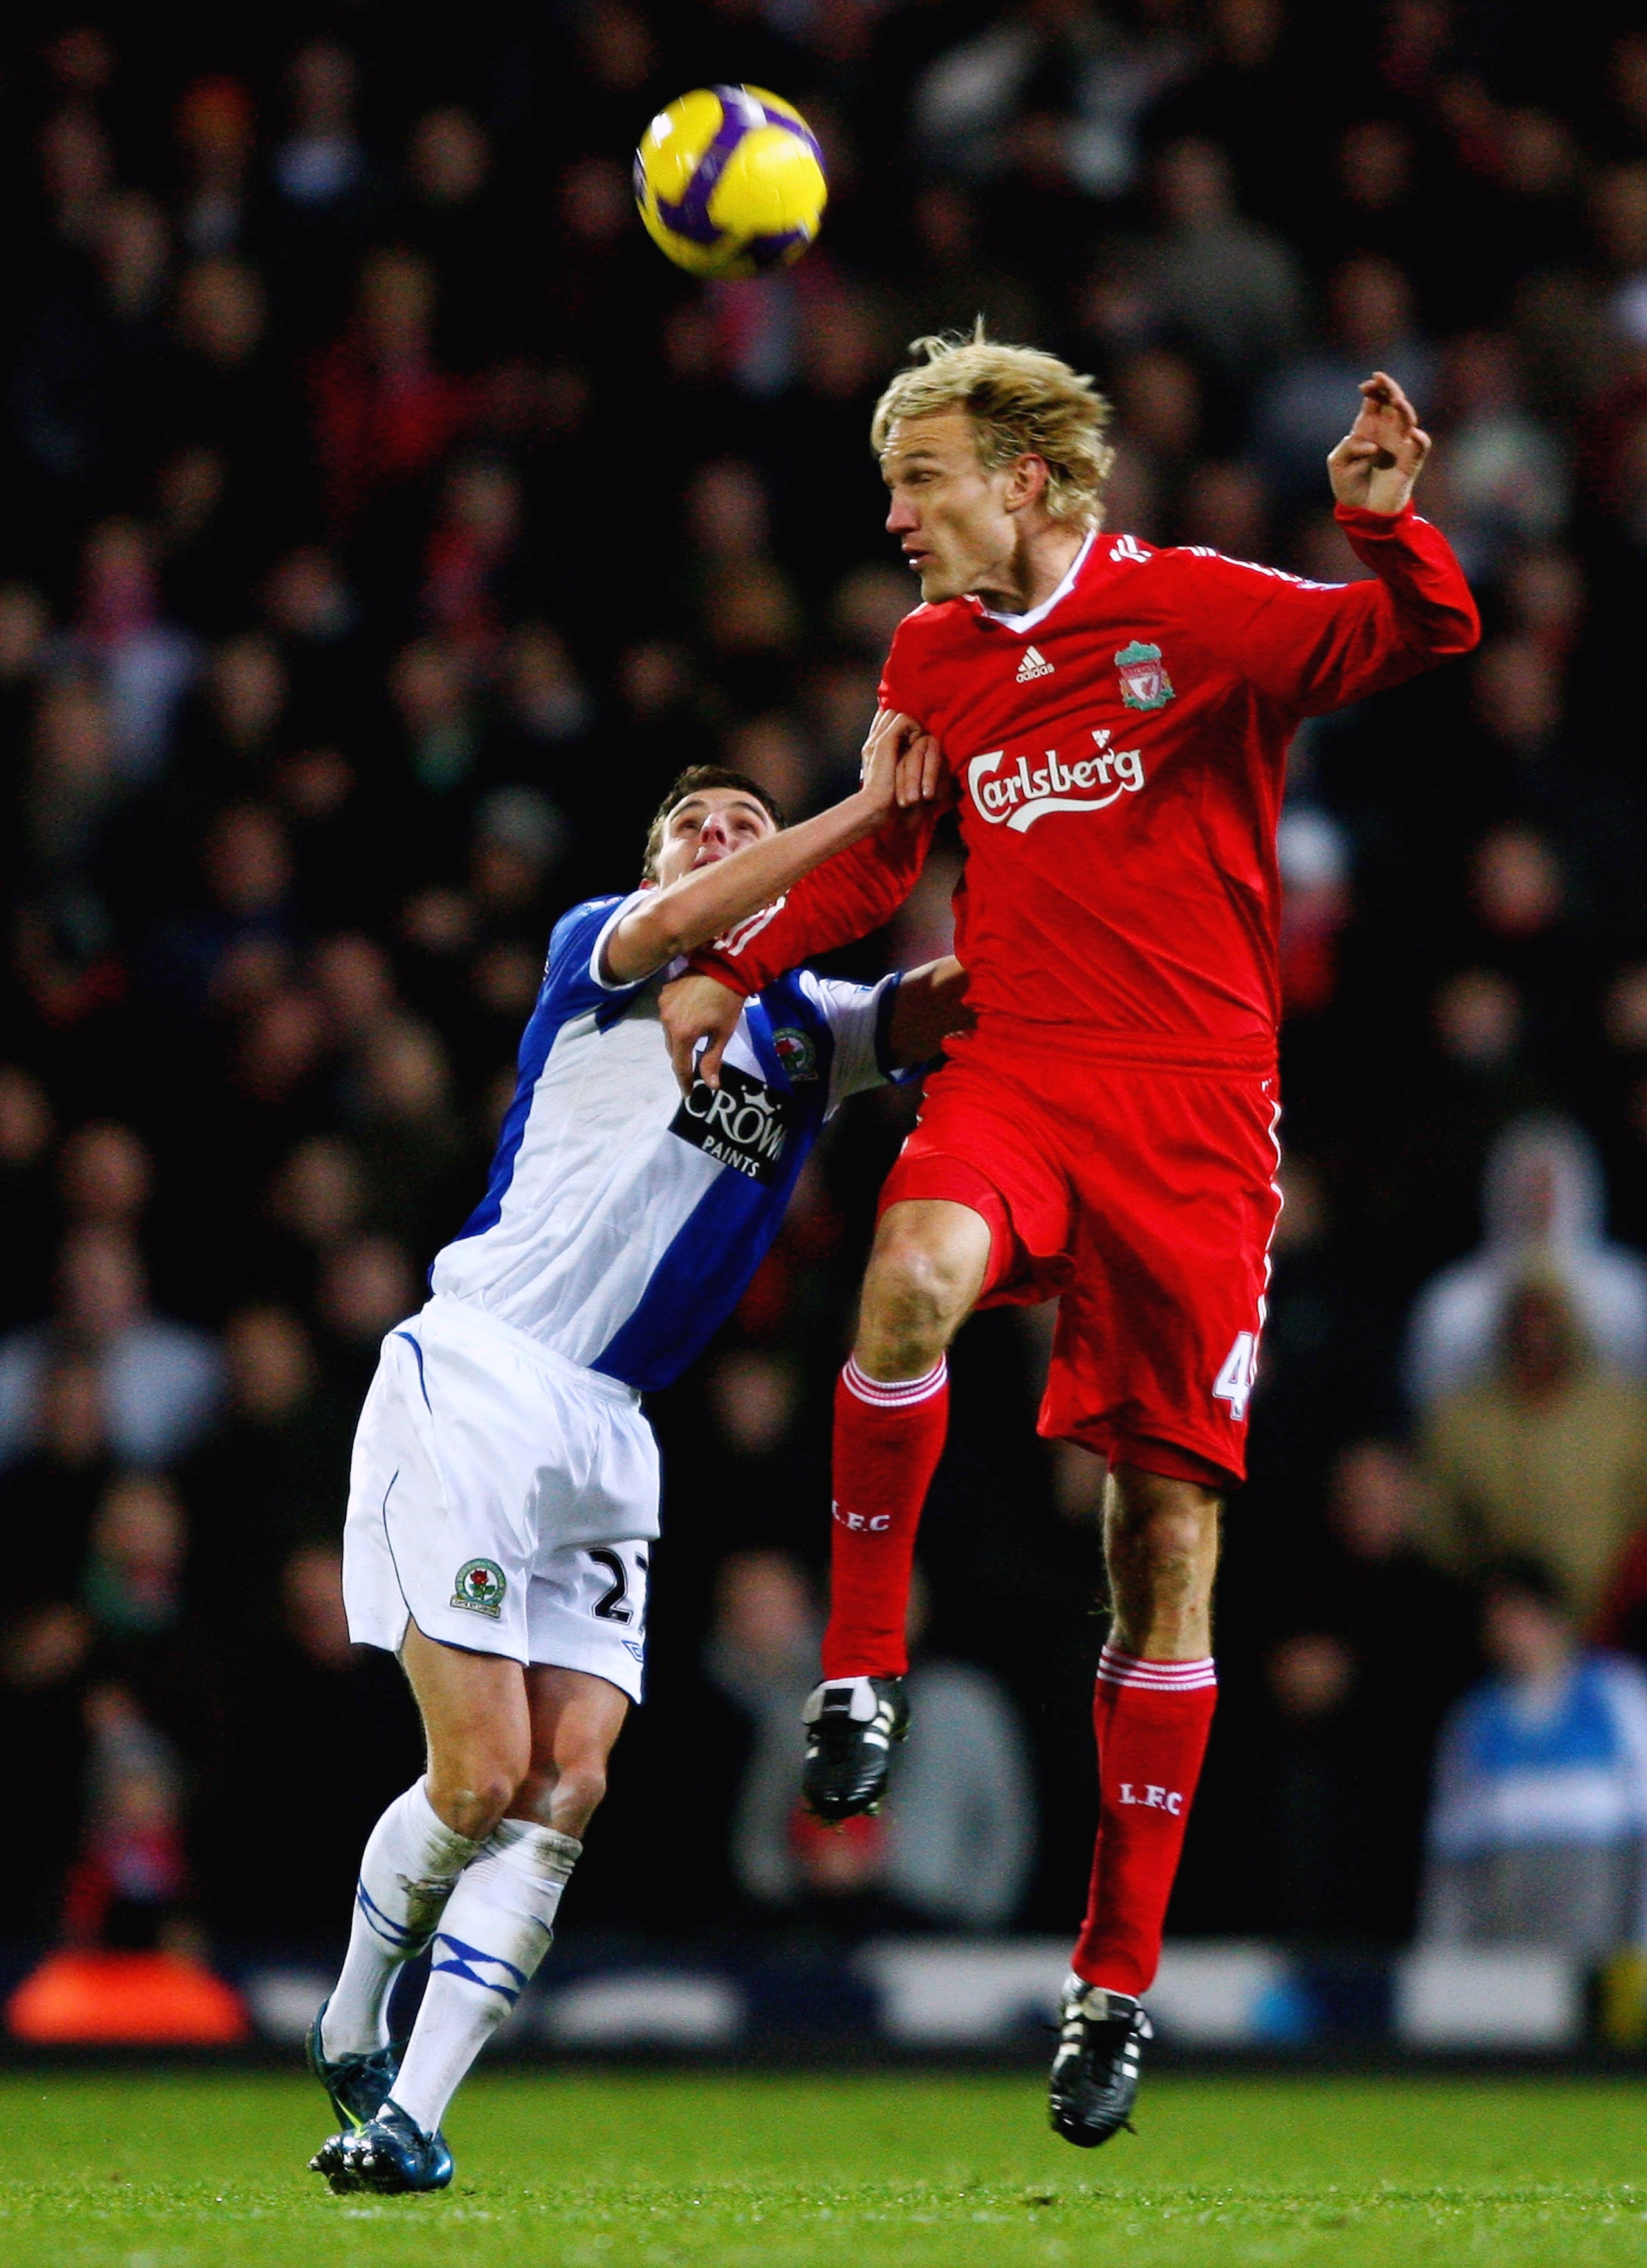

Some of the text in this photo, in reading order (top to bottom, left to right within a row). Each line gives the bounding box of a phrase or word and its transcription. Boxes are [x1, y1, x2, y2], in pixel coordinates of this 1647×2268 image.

[1016, 663, 1055, 684] adidas
[968, 749, 1146, 830] Carlsberg
[701, 1135, 760, 1178] PAINTS
[1212, 1331, 1255, 1422] 4
